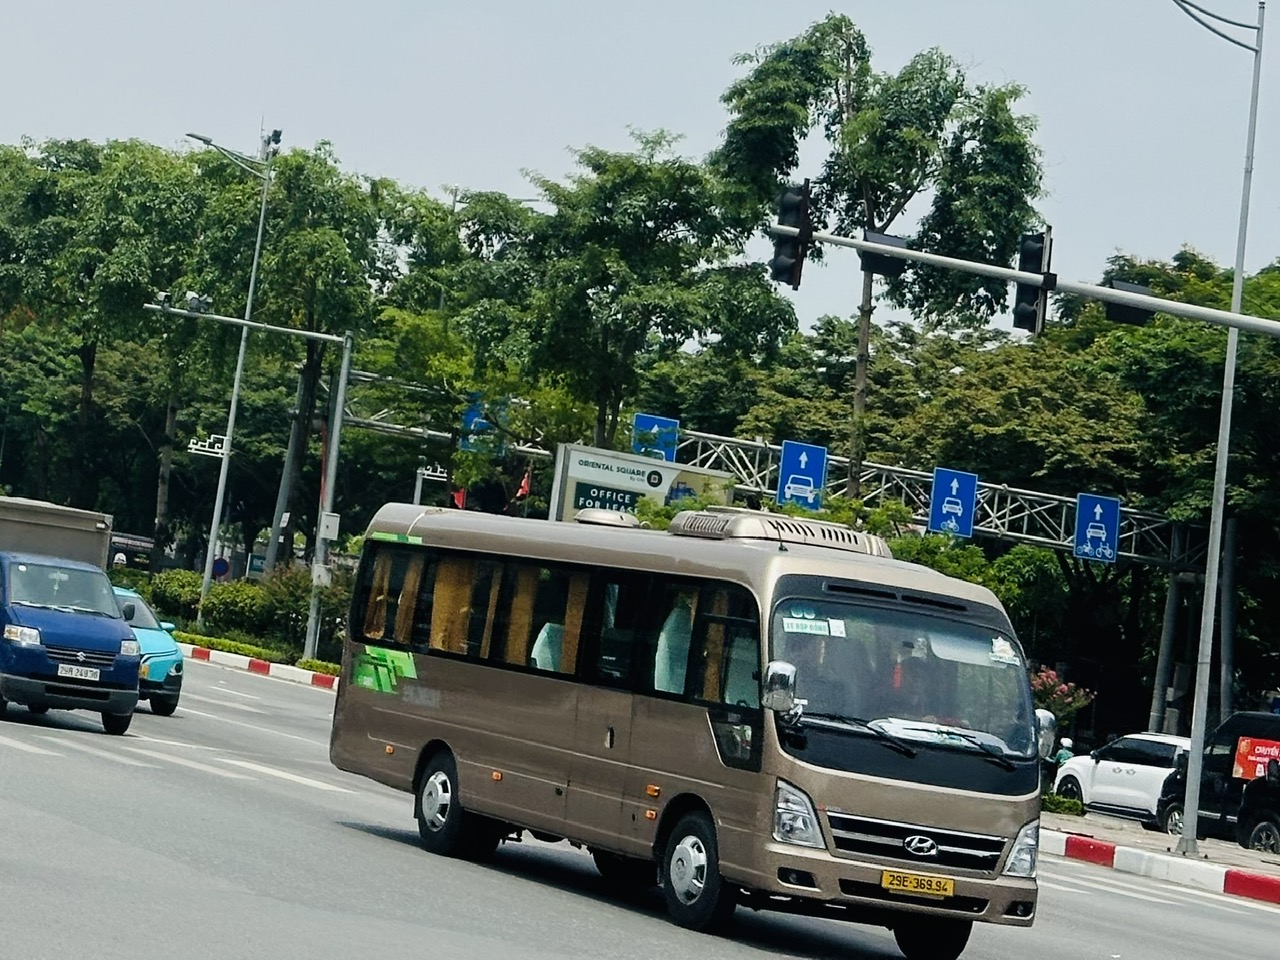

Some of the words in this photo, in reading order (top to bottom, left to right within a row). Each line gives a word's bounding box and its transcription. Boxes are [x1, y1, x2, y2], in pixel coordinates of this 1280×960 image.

[578, 459, 614, 472] ORIENTAL
[616, 466, 646, 478] SQUARE
[579, 497, 600, 509] FOR
[590, 488, 631, 504] OFFICE
